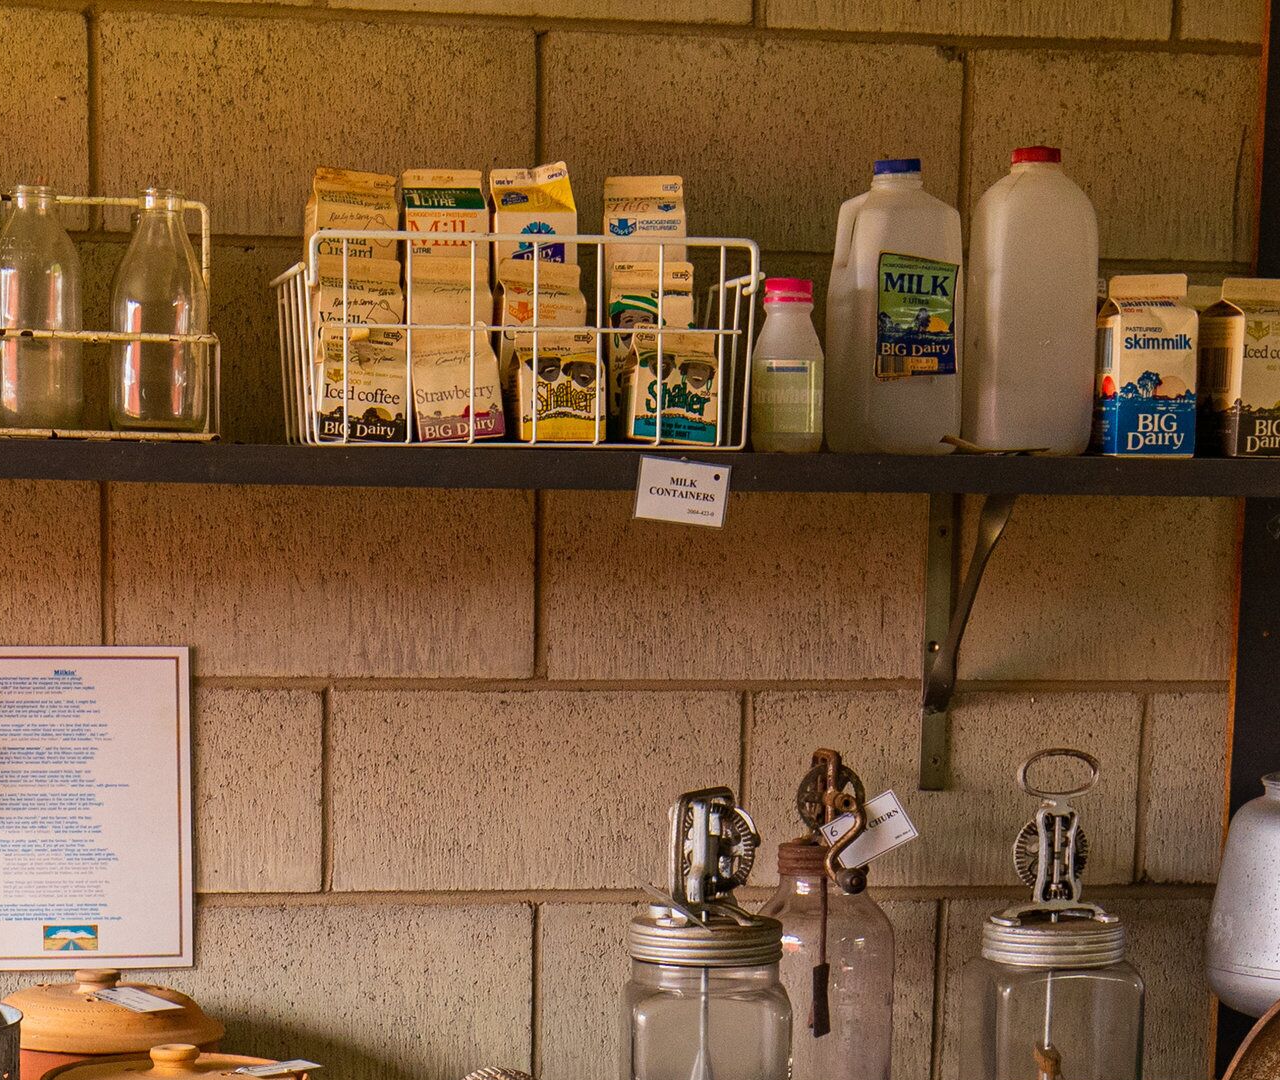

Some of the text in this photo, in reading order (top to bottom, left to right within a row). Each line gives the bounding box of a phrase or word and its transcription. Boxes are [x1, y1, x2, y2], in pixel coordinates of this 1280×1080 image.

[421, 199, 456, 207] LITRE
[524, 248, 554, 261] Diry
[884, 272, 950, 296] MILK
[881, 342, 950, 356] BIG Dairy
[1243, 345, 1268, 359] Iced
[325, 383, 400, 405] Iced coffee
[536, 380, 597, 415] Shaker
[646, 380, 710, 416] Shaker
[324, 422, 395, 437] BIG Dairy
[425, 418, 496, 439] BIG Diry
[1137, 413, 1178, 432] BIG
[1127, 431, 1185, 450] Dairy
[670, 476, 698, 488] MILK
[649, 486, 715, 502] CONTAINERS
[829, 807, 900, 837] 6 CHURN
